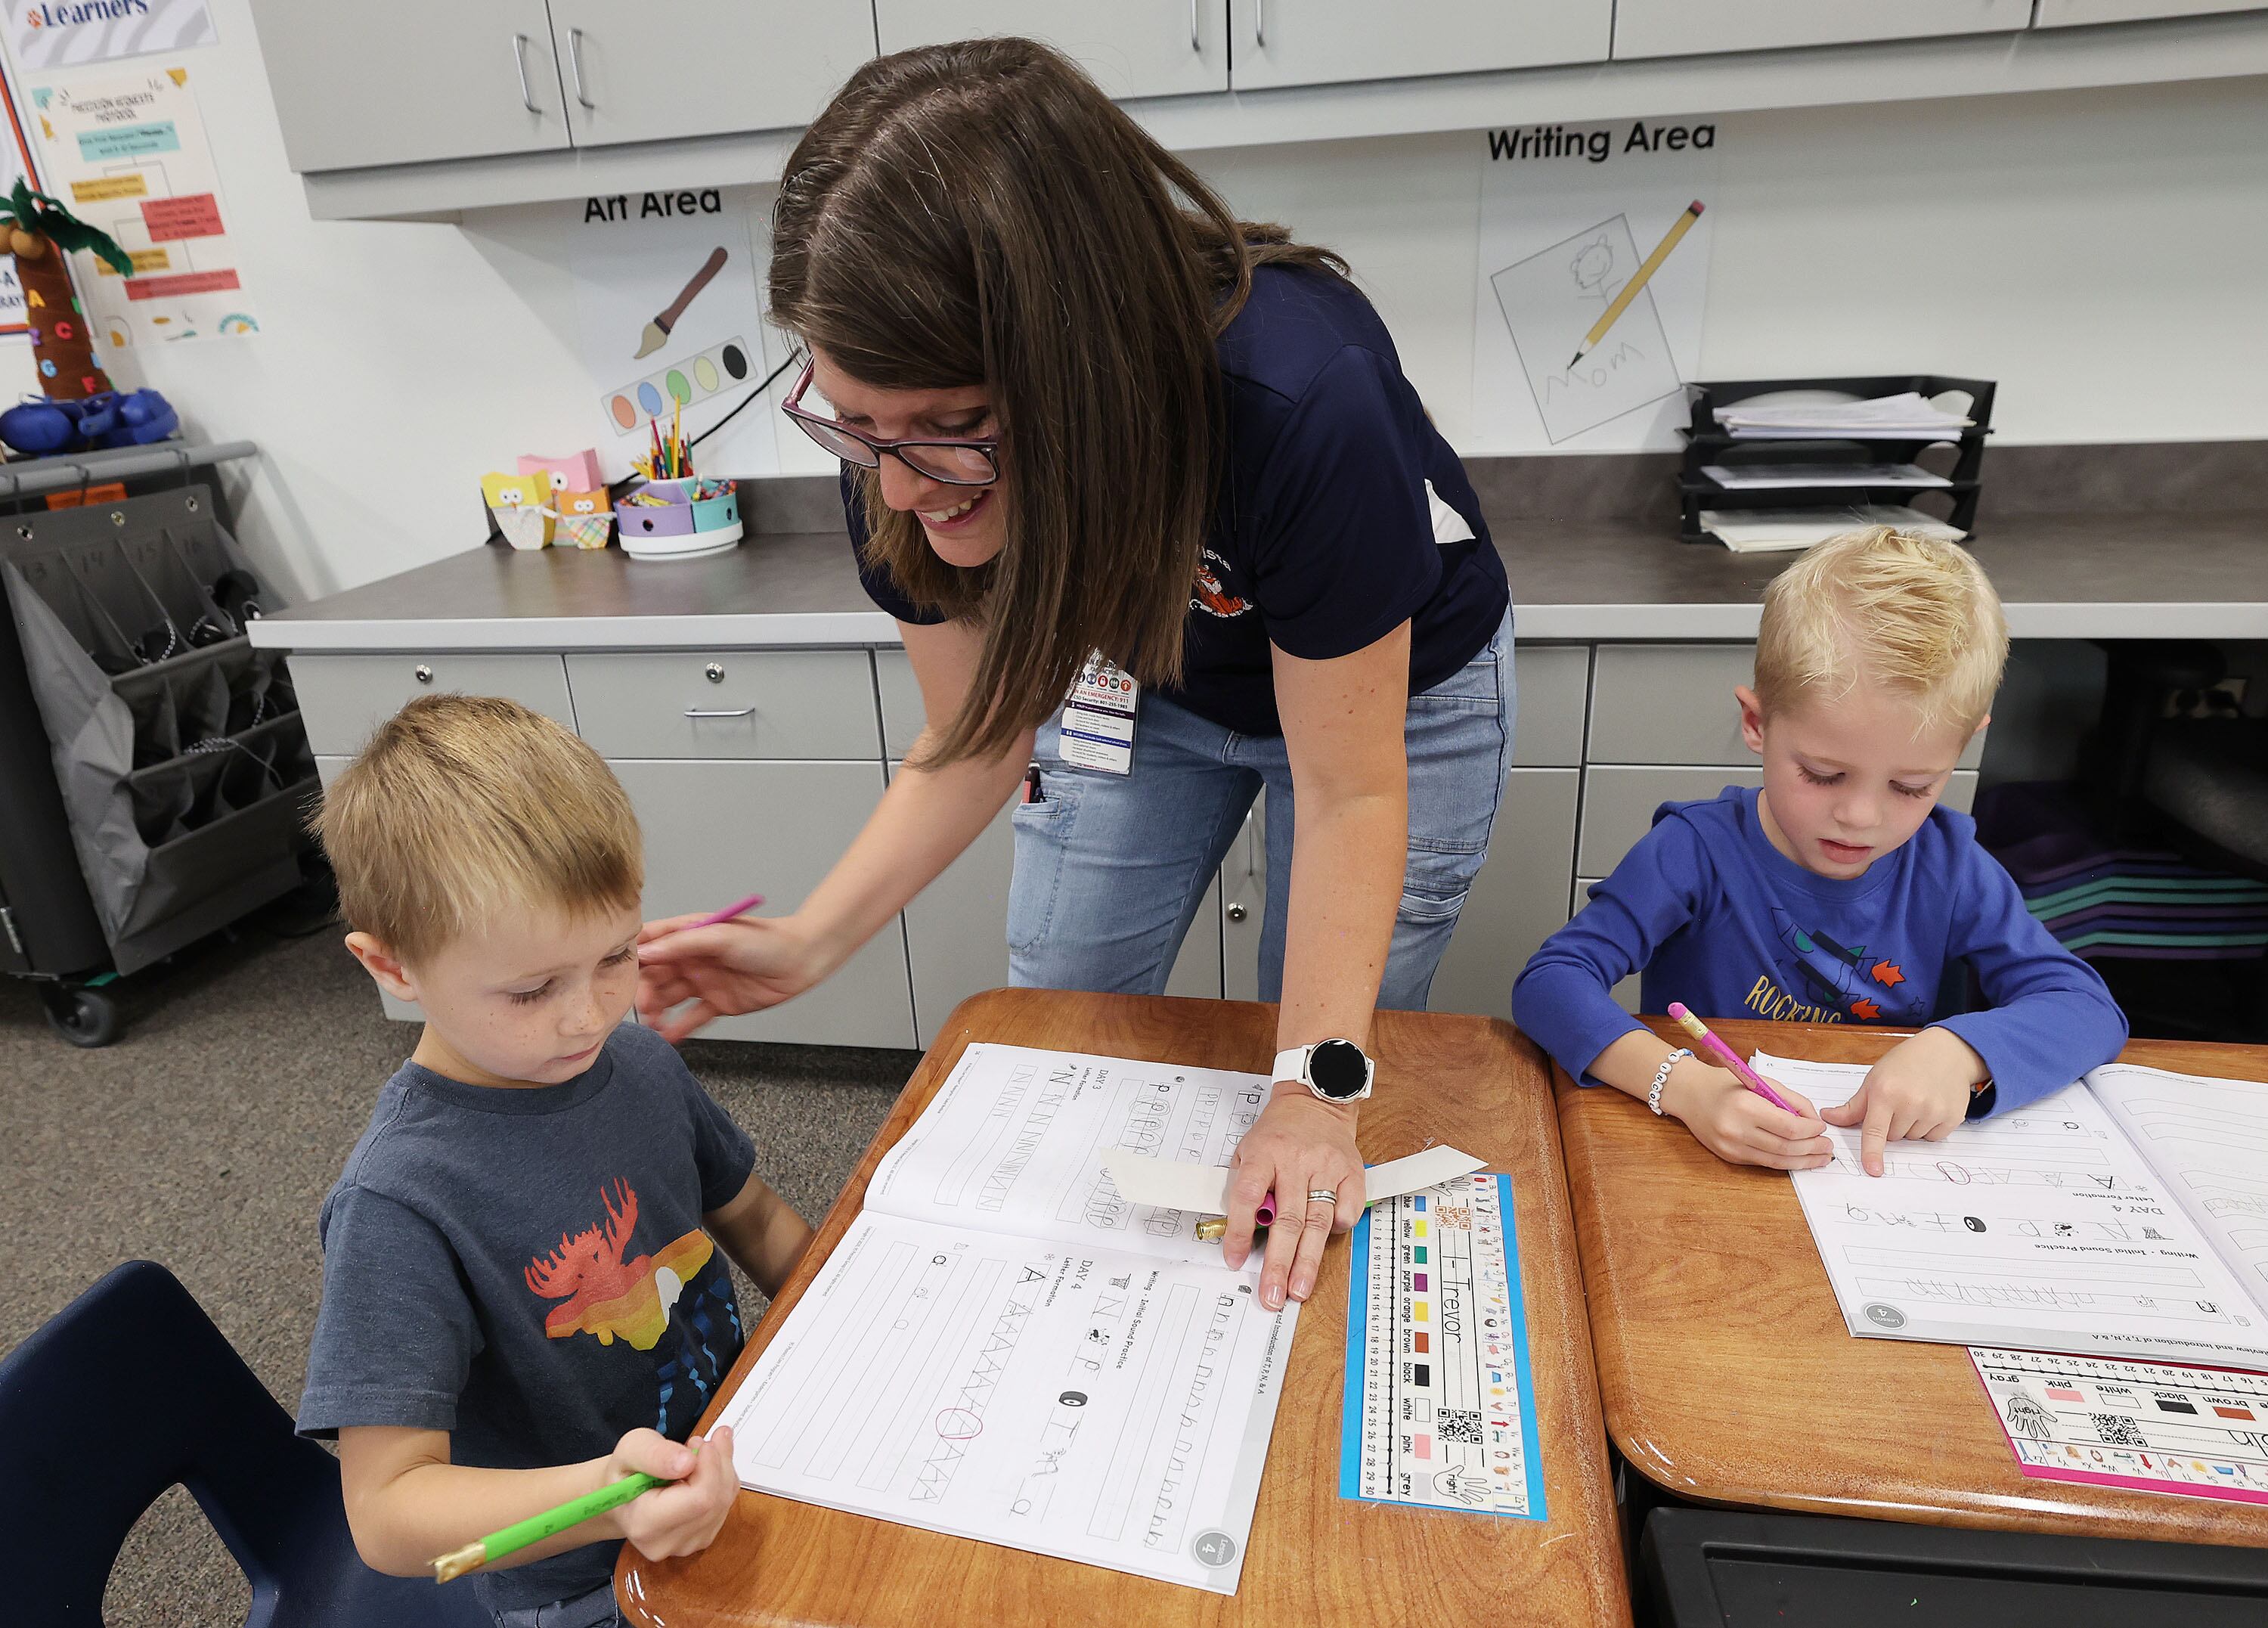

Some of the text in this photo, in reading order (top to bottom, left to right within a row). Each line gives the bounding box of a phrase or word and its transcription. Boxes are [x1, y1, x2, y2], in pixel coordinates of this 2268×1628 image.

[41, 0, 149, 27] Learners
[1488, 121, 1716, 163] Writing Area
[584, 189, 722, 222] Art Area
[1083, 1067, 1092, 1081] Letter
[1095, 1069, 1108, 1084] DAY
[2130, 1206, 2164, 1216] DAY
[1403, 1218, 1411, 1239] yellow
[1402, 1245, 1411, 1264] green
[2115, 1248, 2146, 1256] Initial
[2160, 1249, 2199, 1260] Writing
[1076, 1261, 1093, 1281] DAY
[1045, 1257, 1074, 1307] Letter Formation
[1402, 1270, 1411, 1292] purple
[1402, 1297, 1411, 1323] orange
[1443, 1278, 1470, 1343] Trevor
[1117, 1271, 1160, 1369] Writing Initial Sound Practice
[1404, 1329, 1412, 1354] brown
[2155, 1337, 2213, 1350] Introduction
[2214, 1342, 2233, 1350] and
[1404, 1363, 1413, 1383] black
[1369, 1394, 1377, 1402] 23
[1989, 1373, 2250, 1409] brown black white pink gray
[1368, 1406, 1377, 1414] 24
[1403, 1397, 1413, 1421] white
[2014, 1406, 2040, 1416] right
[1368, 1419, 1377, 1427] 25
[1368, 1431, 1377, 1440] 26
[1401, 1435, 1413, 1454] pink
[1368, 1444, 1376, 1453] 27
[1366, 1458, 1376, 1466] 28
[1366, 1471, 1375, 1481] 29
[1400, 1472, 1411, 1496] grey
[1446, 1474, 1458, 1494] right
[1366, 1487, 1374, 1495] 30
[1202, 1543, 1216, 1553] 4
[1216, 1539, 1228, 1564] Lesson
